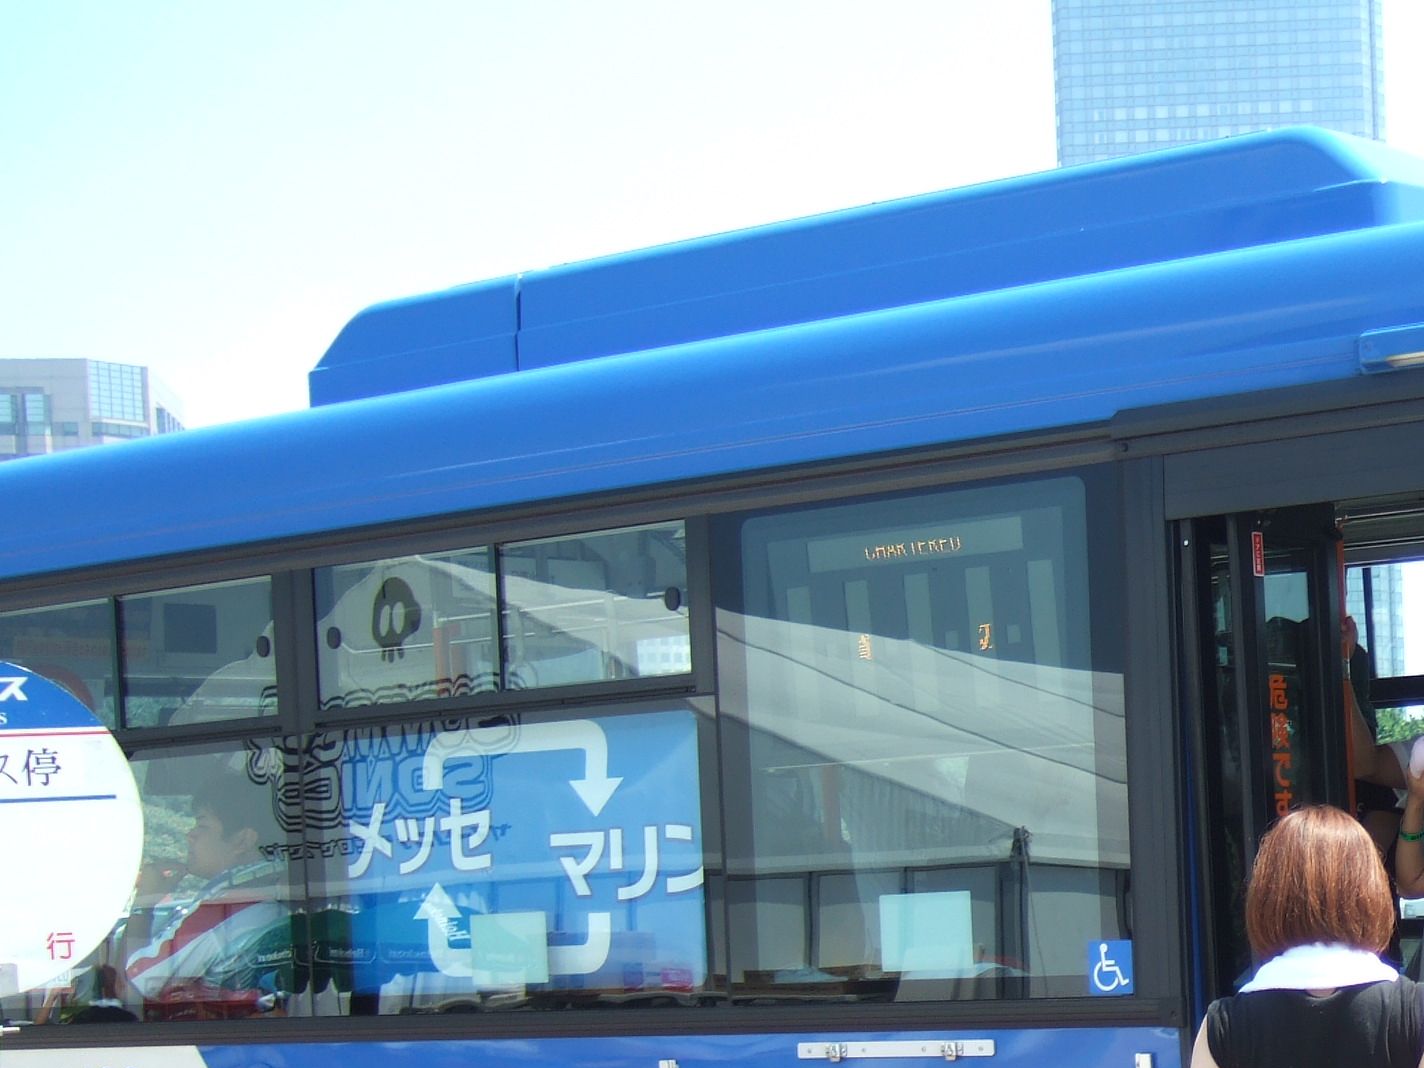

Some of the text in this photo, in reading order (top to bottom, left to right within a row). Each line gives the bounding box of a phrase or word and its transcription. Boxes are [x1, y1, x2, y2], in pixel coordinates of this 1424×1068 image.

[348, 798, 492, 879] メッセ
[550, 823, 704, 901] マリン
[46, 931, 76, 961] 行
